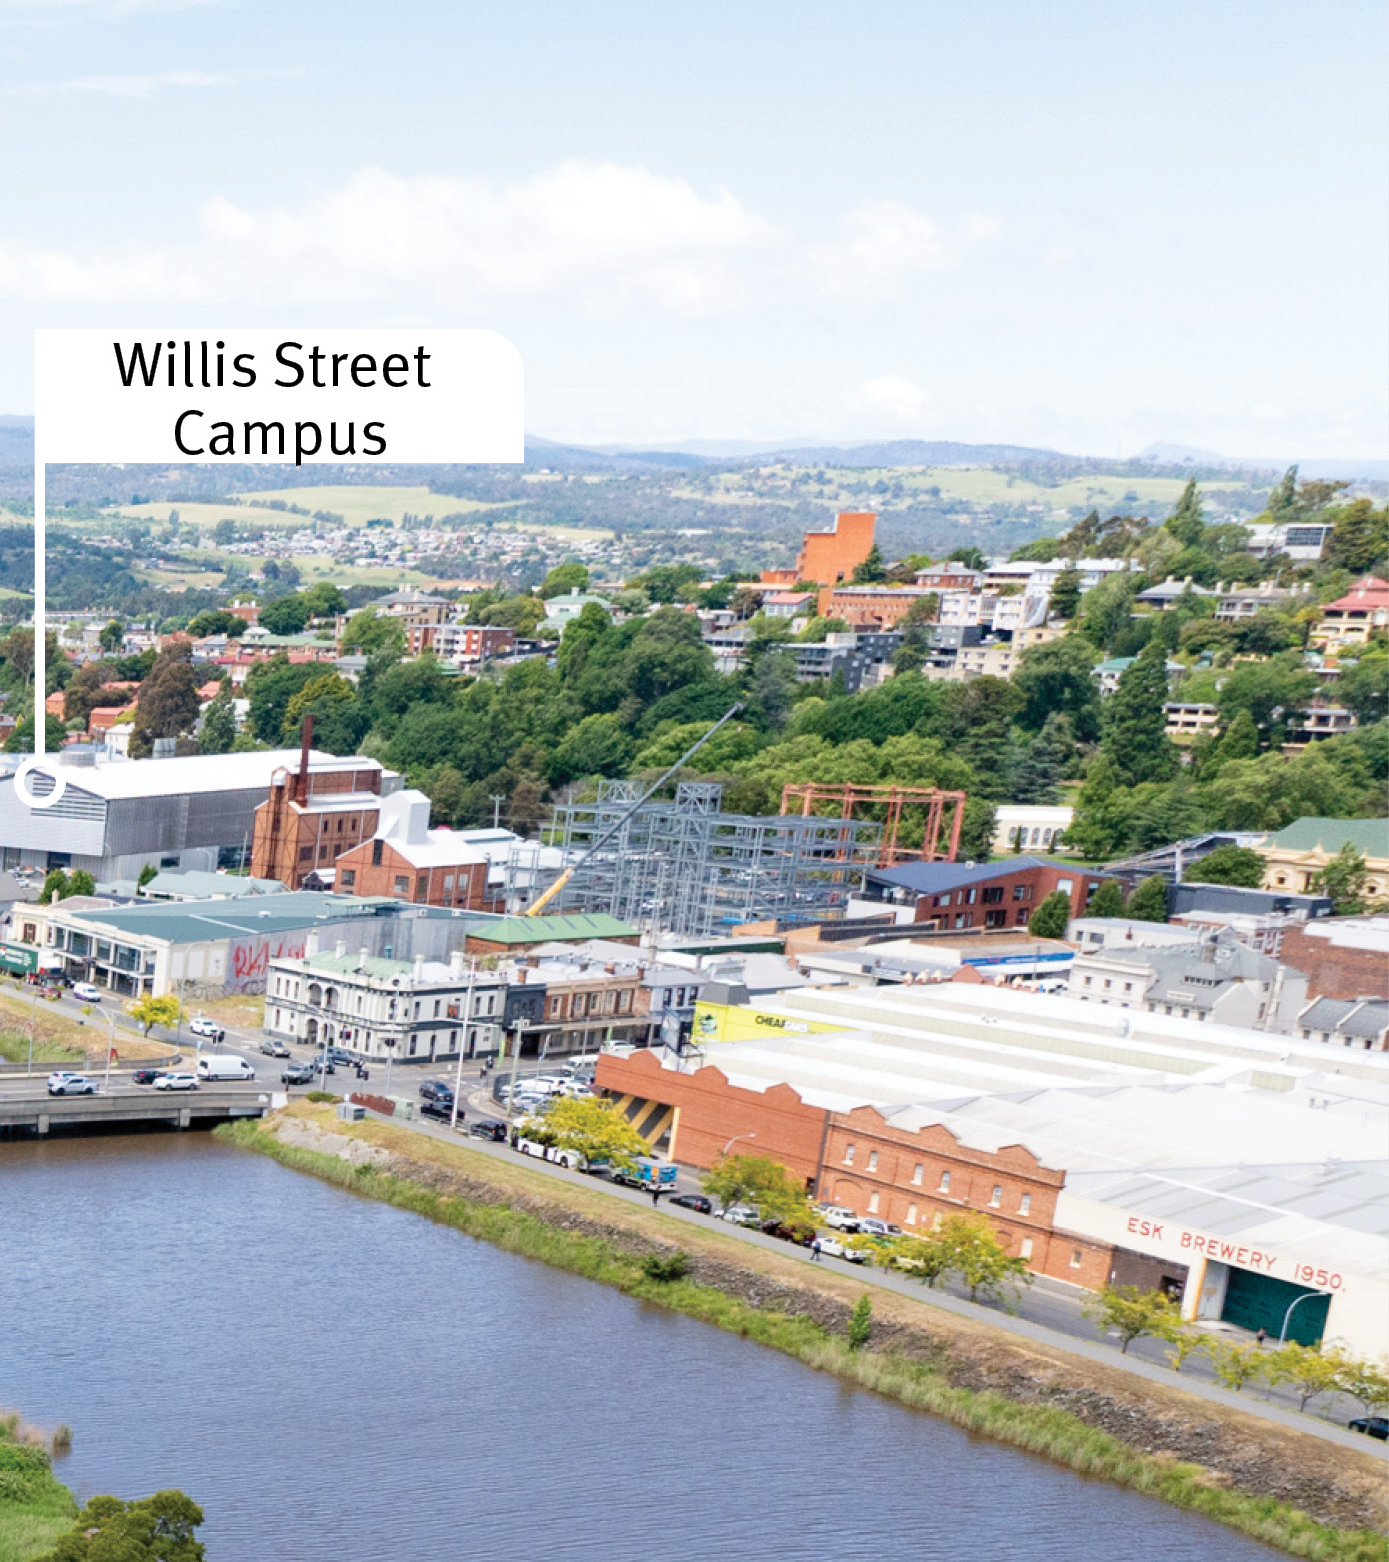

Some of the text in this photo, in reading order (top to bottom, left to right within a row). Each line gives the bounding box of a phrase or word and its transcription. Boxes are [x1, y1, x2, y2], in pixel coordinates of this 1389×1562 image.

[1126, 1217, 1347, 1293] ESK BREWERY 1950.
